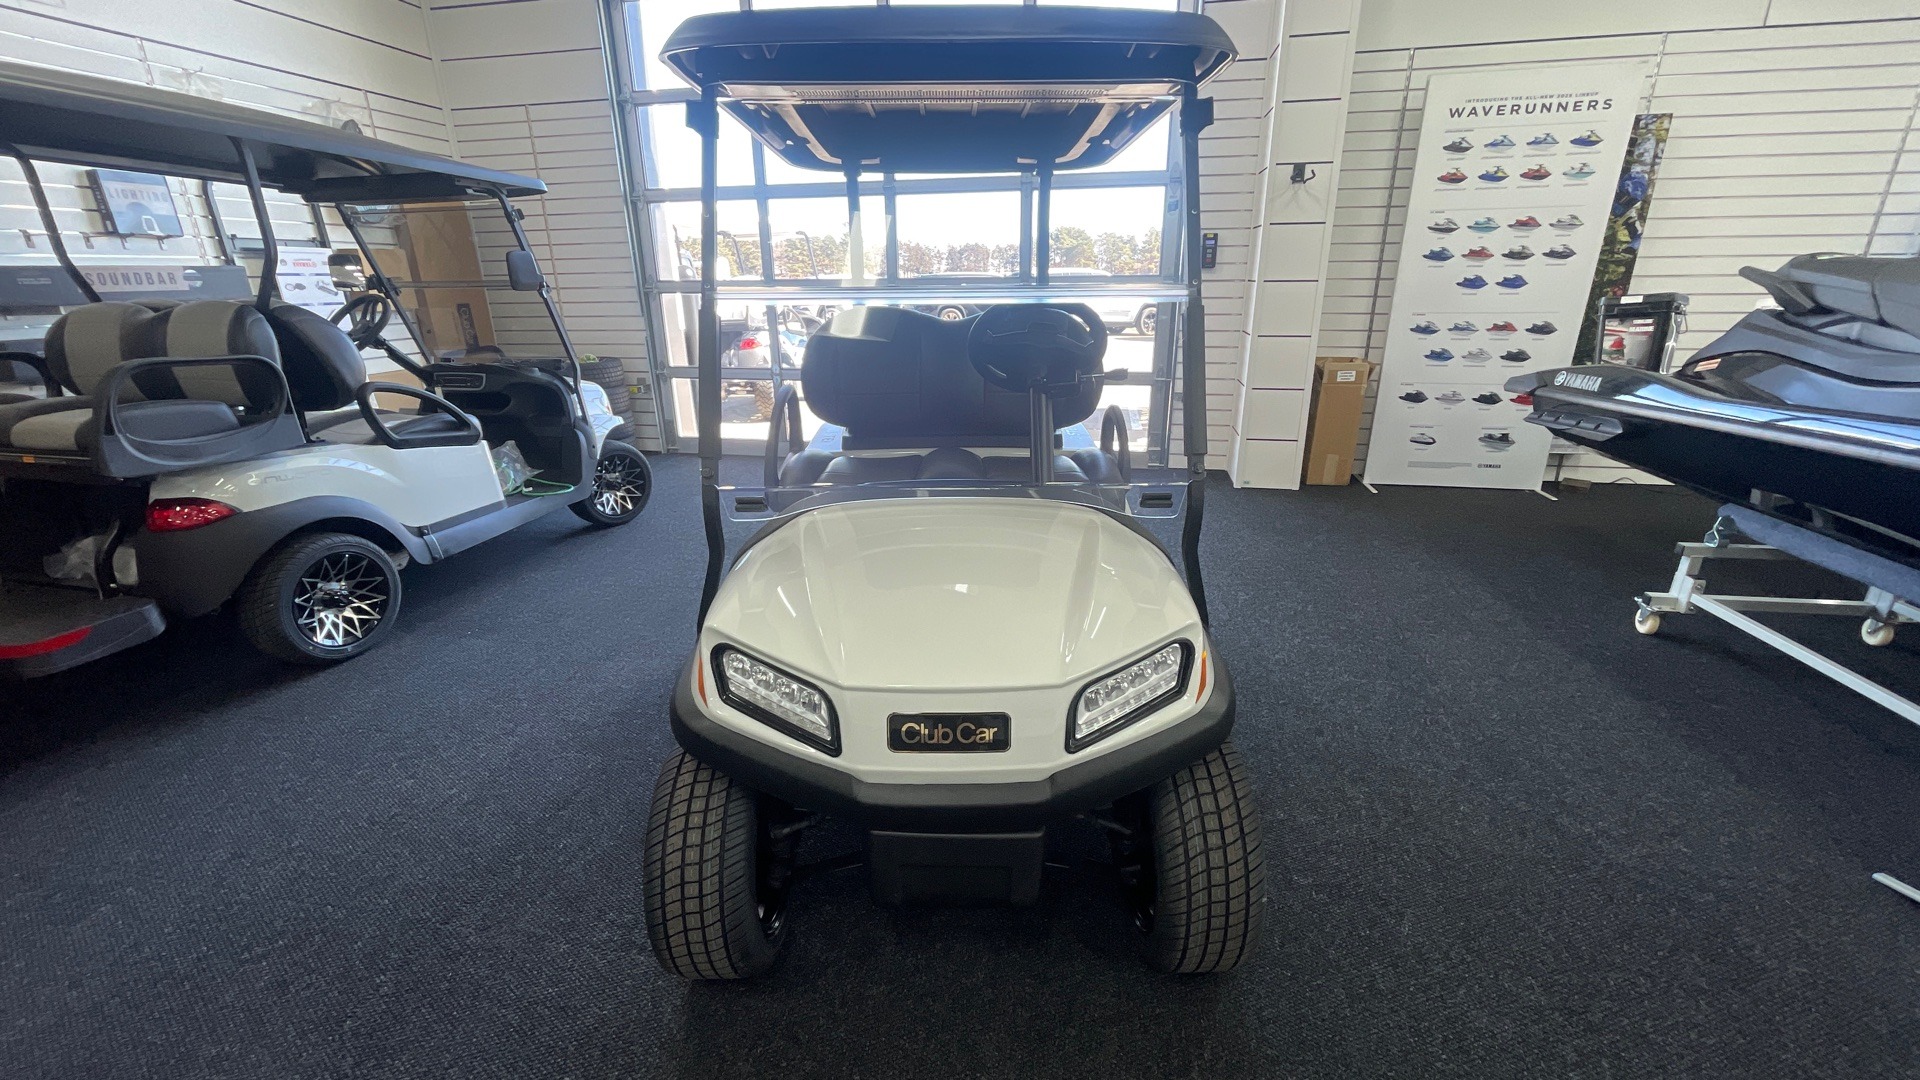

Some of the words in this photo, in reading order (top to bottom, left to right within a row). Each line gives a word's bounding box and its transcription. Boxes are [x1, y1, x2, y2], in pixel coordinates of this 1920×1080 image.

[1449, 98, 1613, 119] WAVERUNNERS
[107, 186, 169, 203] LIGHTING
[84, 271, 178, 287] SOUNDBAR
[1563, 372, 1603, 392] YAMAHA
[900, 722, 954, 744] Club
[956, 722, 998, 744] Car
